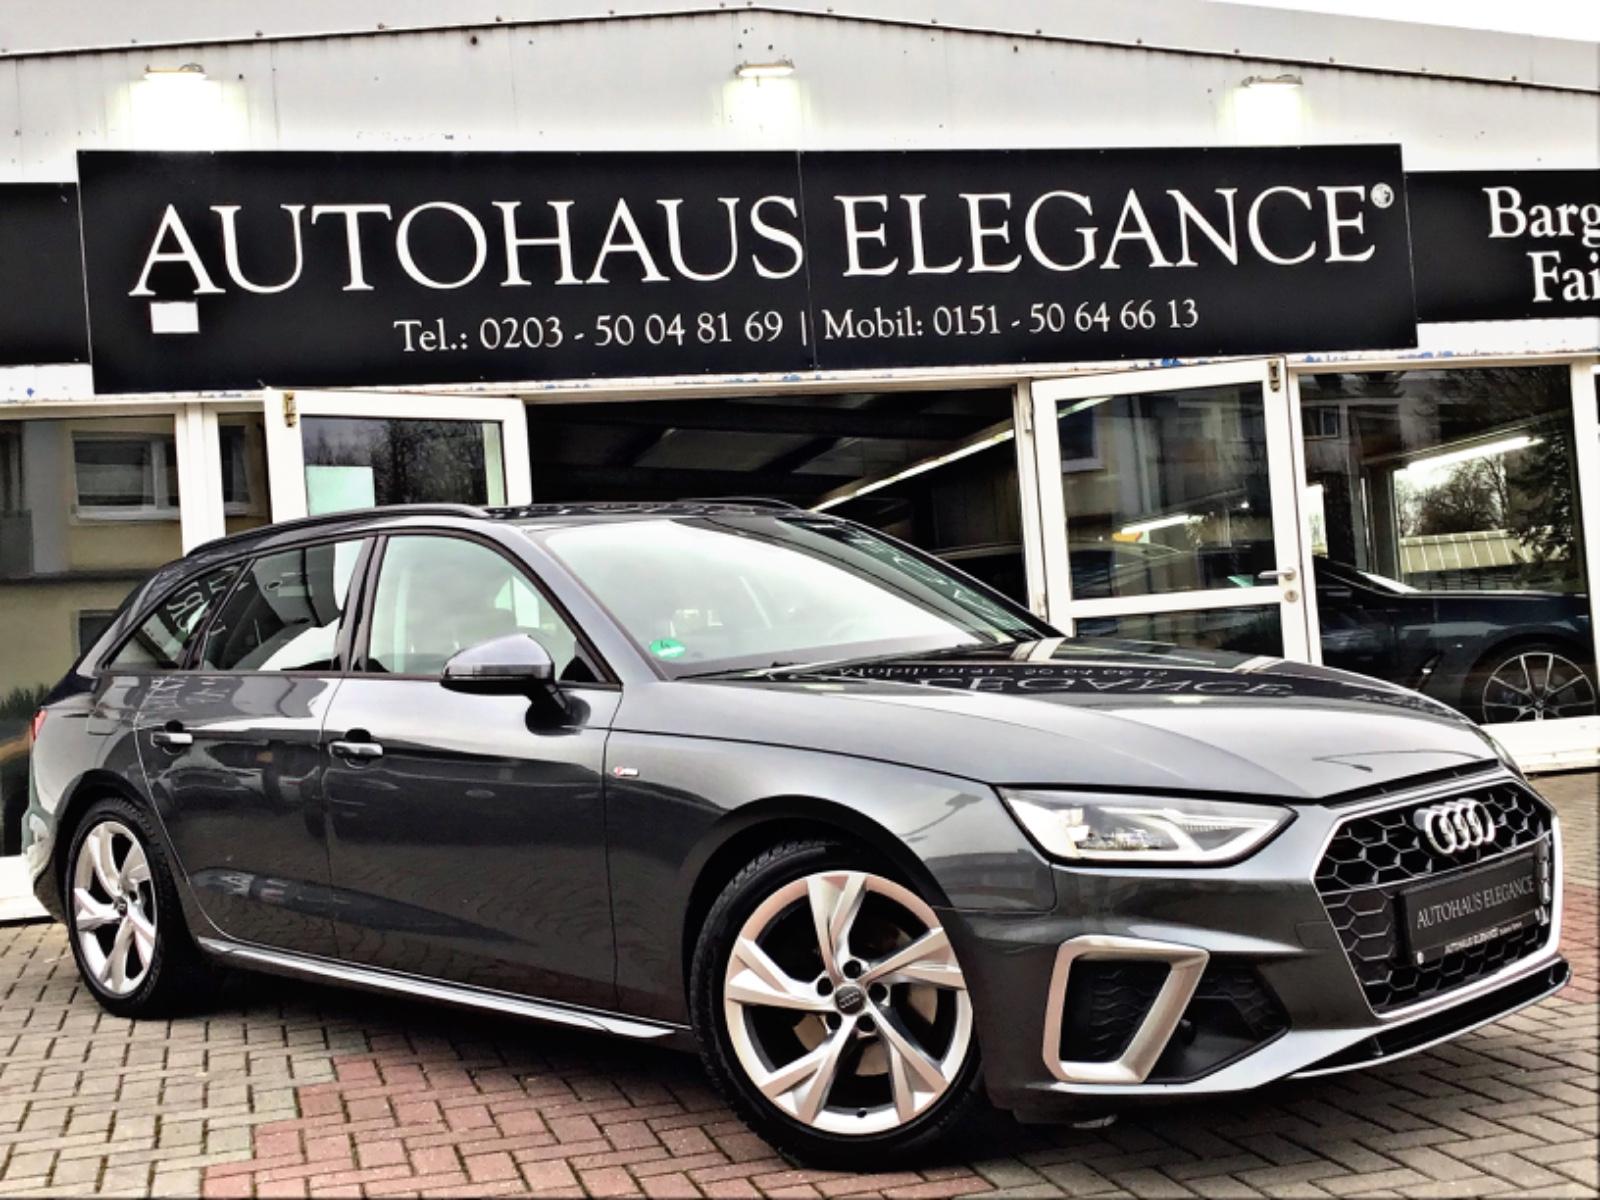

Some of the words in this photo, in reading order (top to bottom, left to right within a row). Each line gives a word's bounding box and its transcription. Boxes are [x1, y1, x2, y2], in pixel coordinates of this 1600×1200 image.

[128, 195, 804, 297] AUTOHAUS
[833, 184, 1376, 277] ELEGANCE
[1482, 185, 1600, 248] Barg
[1525, 250, 1600, 302] Fai
[393, 319, 468, 352] Tel.:
[479, 315, 563, 350] 0203
[595, 314, 635, 346] 50
[645, 313, 686, 346] 04
[697, 311, 732, 344] 81
[744, 310, 783, 342] 69
[822, 305, 923, 340] Mobil:
[933, 303, 1001, 336] 0151
[1029, 303, 1065, 333] 50
[1074, 301, 1111, 332] 64
[1120, 299, 1156, 330] 66
[1168, 298, 1199, 328] 13
[1417, 893, 1484, 929] AUTOHAUS
[1484, 876, 1535, 908] ELEGANCE
